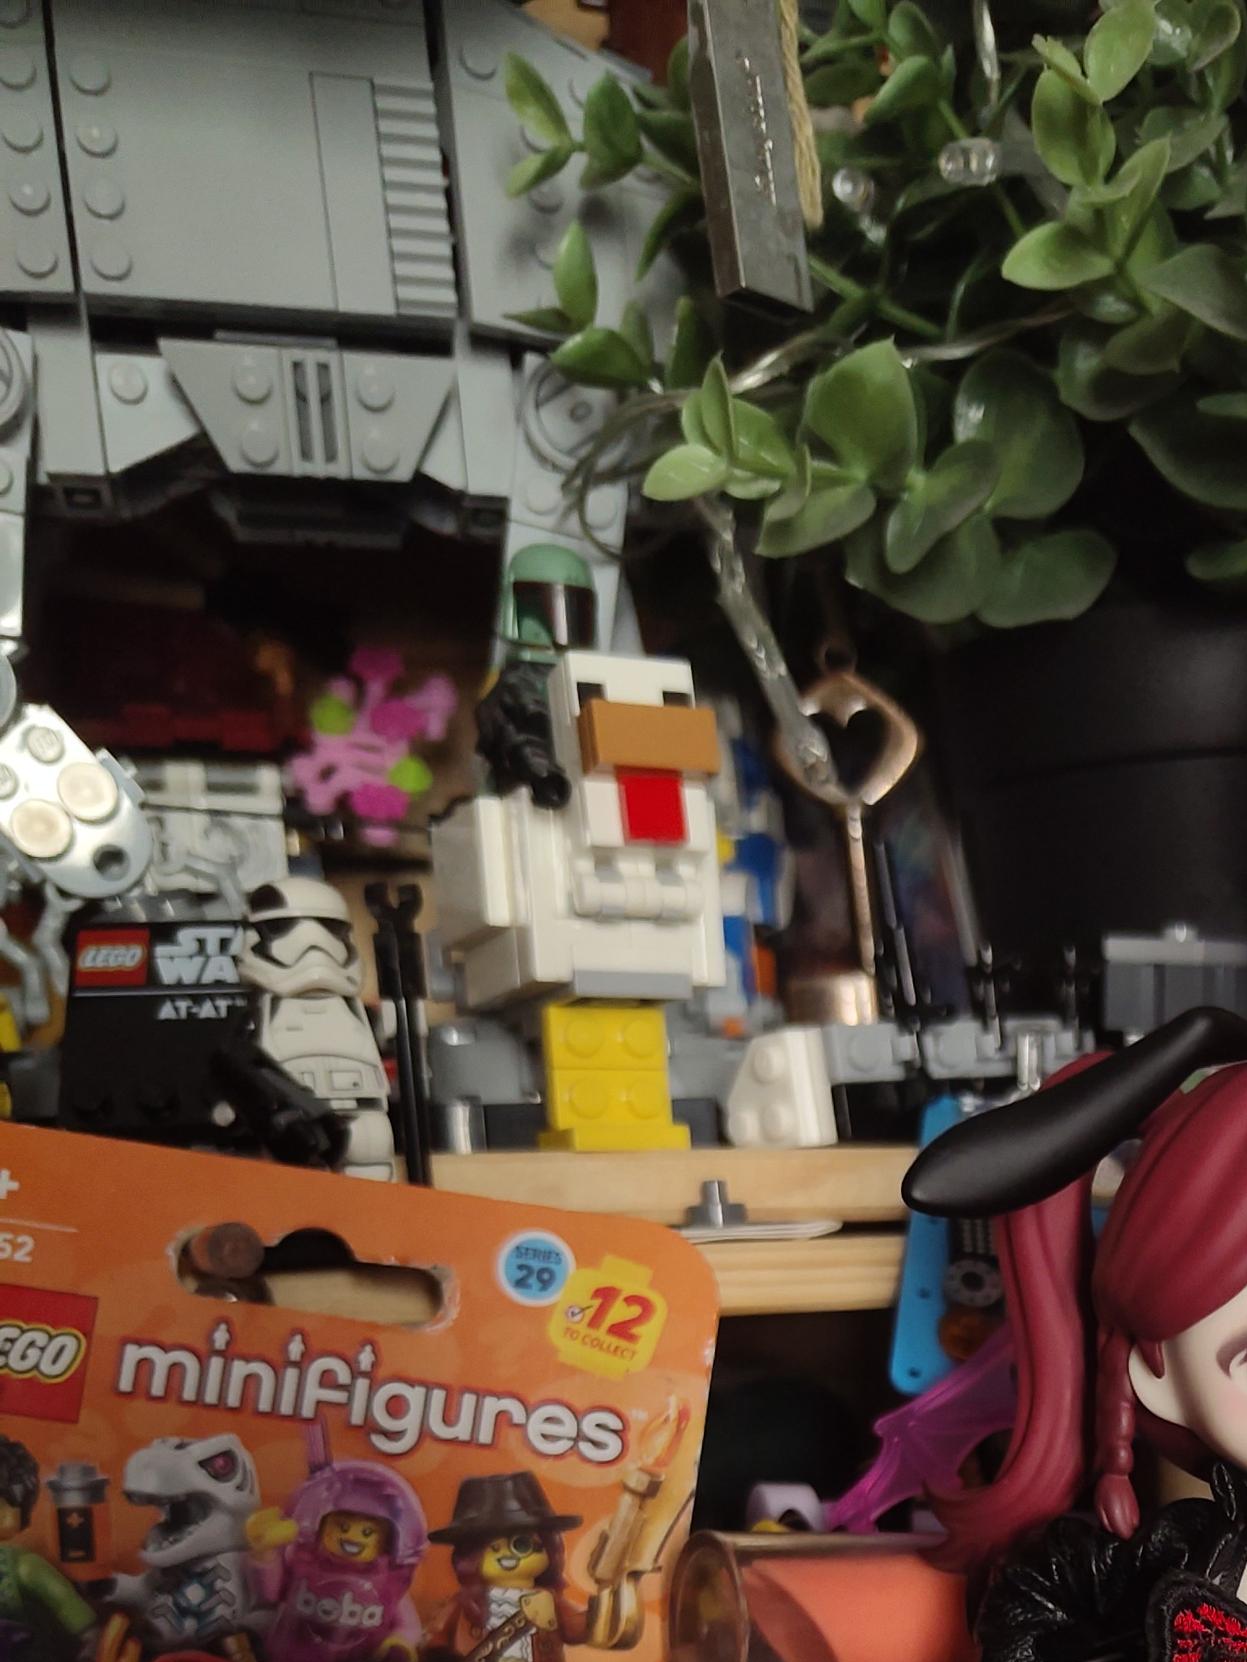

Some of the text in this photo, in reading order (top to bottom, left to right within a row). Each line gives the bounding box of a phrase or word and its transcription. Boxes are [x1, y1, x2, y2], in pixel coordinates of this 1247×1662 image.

[79, 943, 146, 971] LEGO
[514, 1245, 563, 1266] SERIES
[514, 1264, 557, 1293] 29
[587, 1286, 657, 1344] 12
[563, 1327, 637, 1361] TO COLLECT
[116, 1316, 626, 1464] minifigures
[298, 1588, 385, 1628] boba
